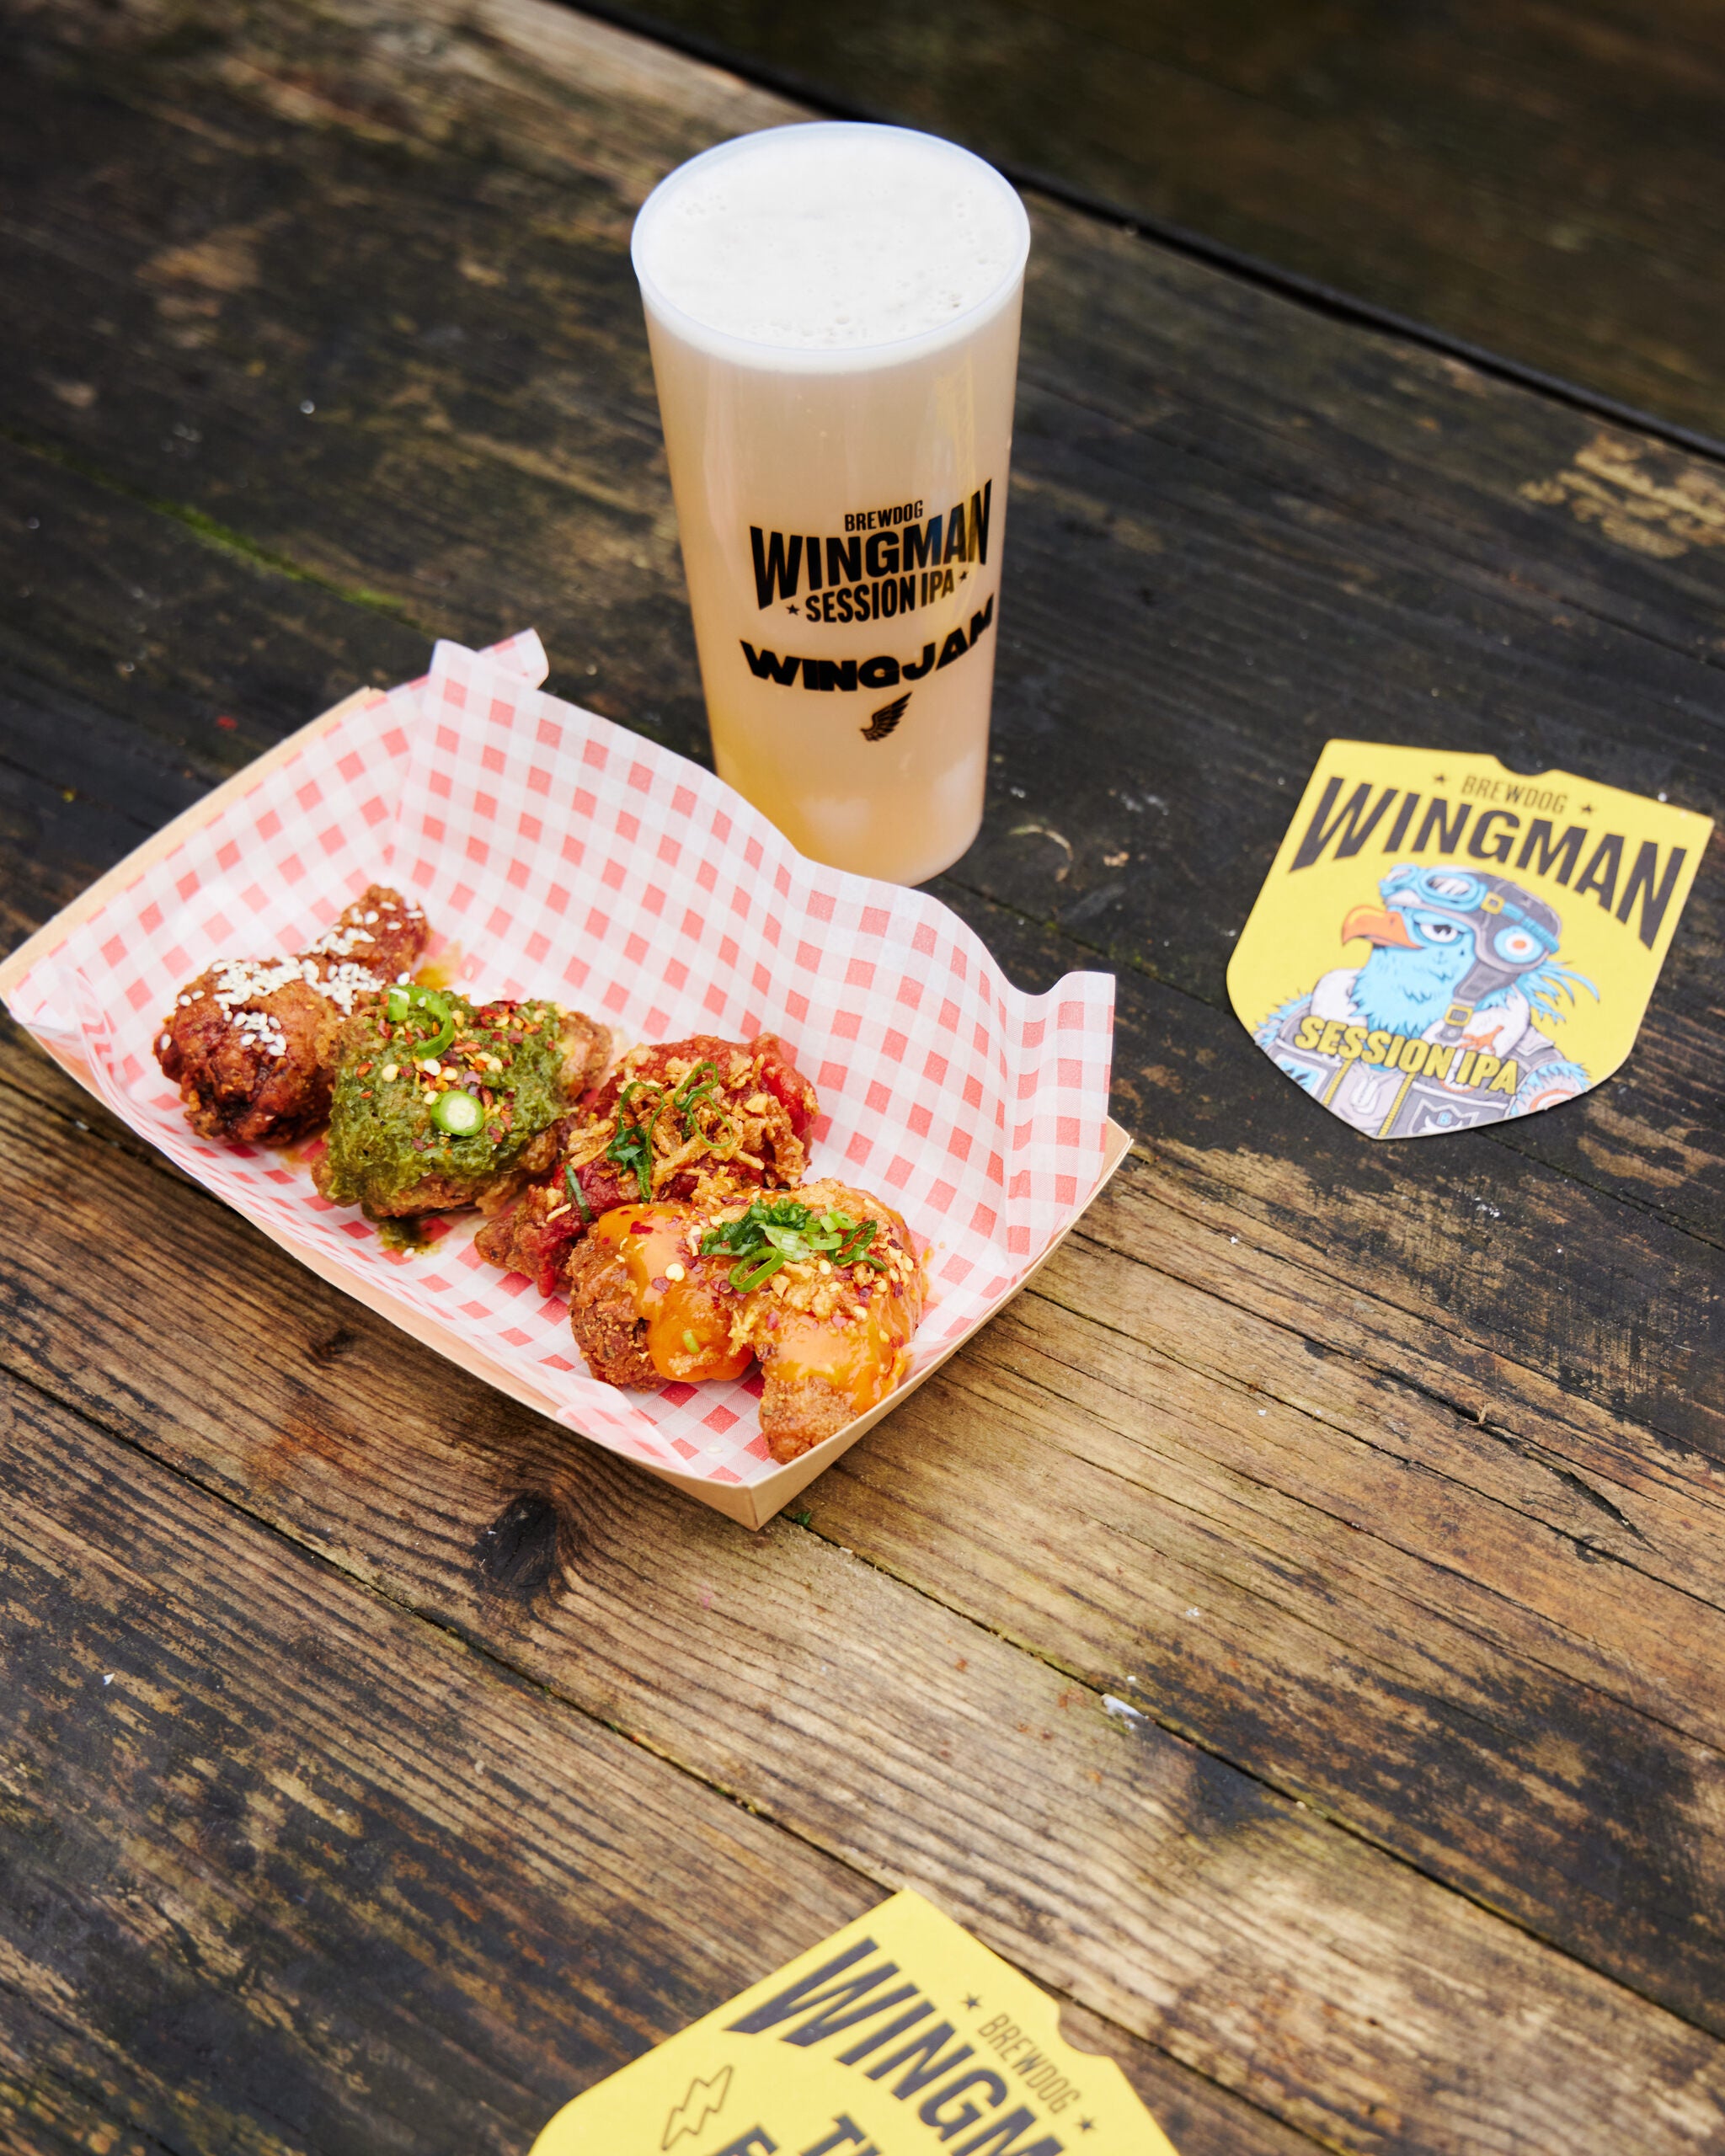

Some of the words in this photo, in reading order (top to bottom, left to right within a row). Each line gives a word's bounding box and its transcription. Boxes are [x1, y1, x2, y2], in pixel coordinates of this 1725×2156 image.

[750, 479, 992, 611] WINGMAN
[845, 500, 923, 531] BREWDOG
[805, 575, 916, 623] SESSION
[921, 569, 955, 607] IPA
[740, 593, 994, 691] WINGJAM
[1461, 776, 1568, 814] BREWDOG
[1289, 777, 1688, 950] WINGMAN
[1295, 1016, 1456, 1080] SESSION
[1455, 1050, 1518, 1095] IPA
[978, 2013, 1081, 2115] BREWDOG
